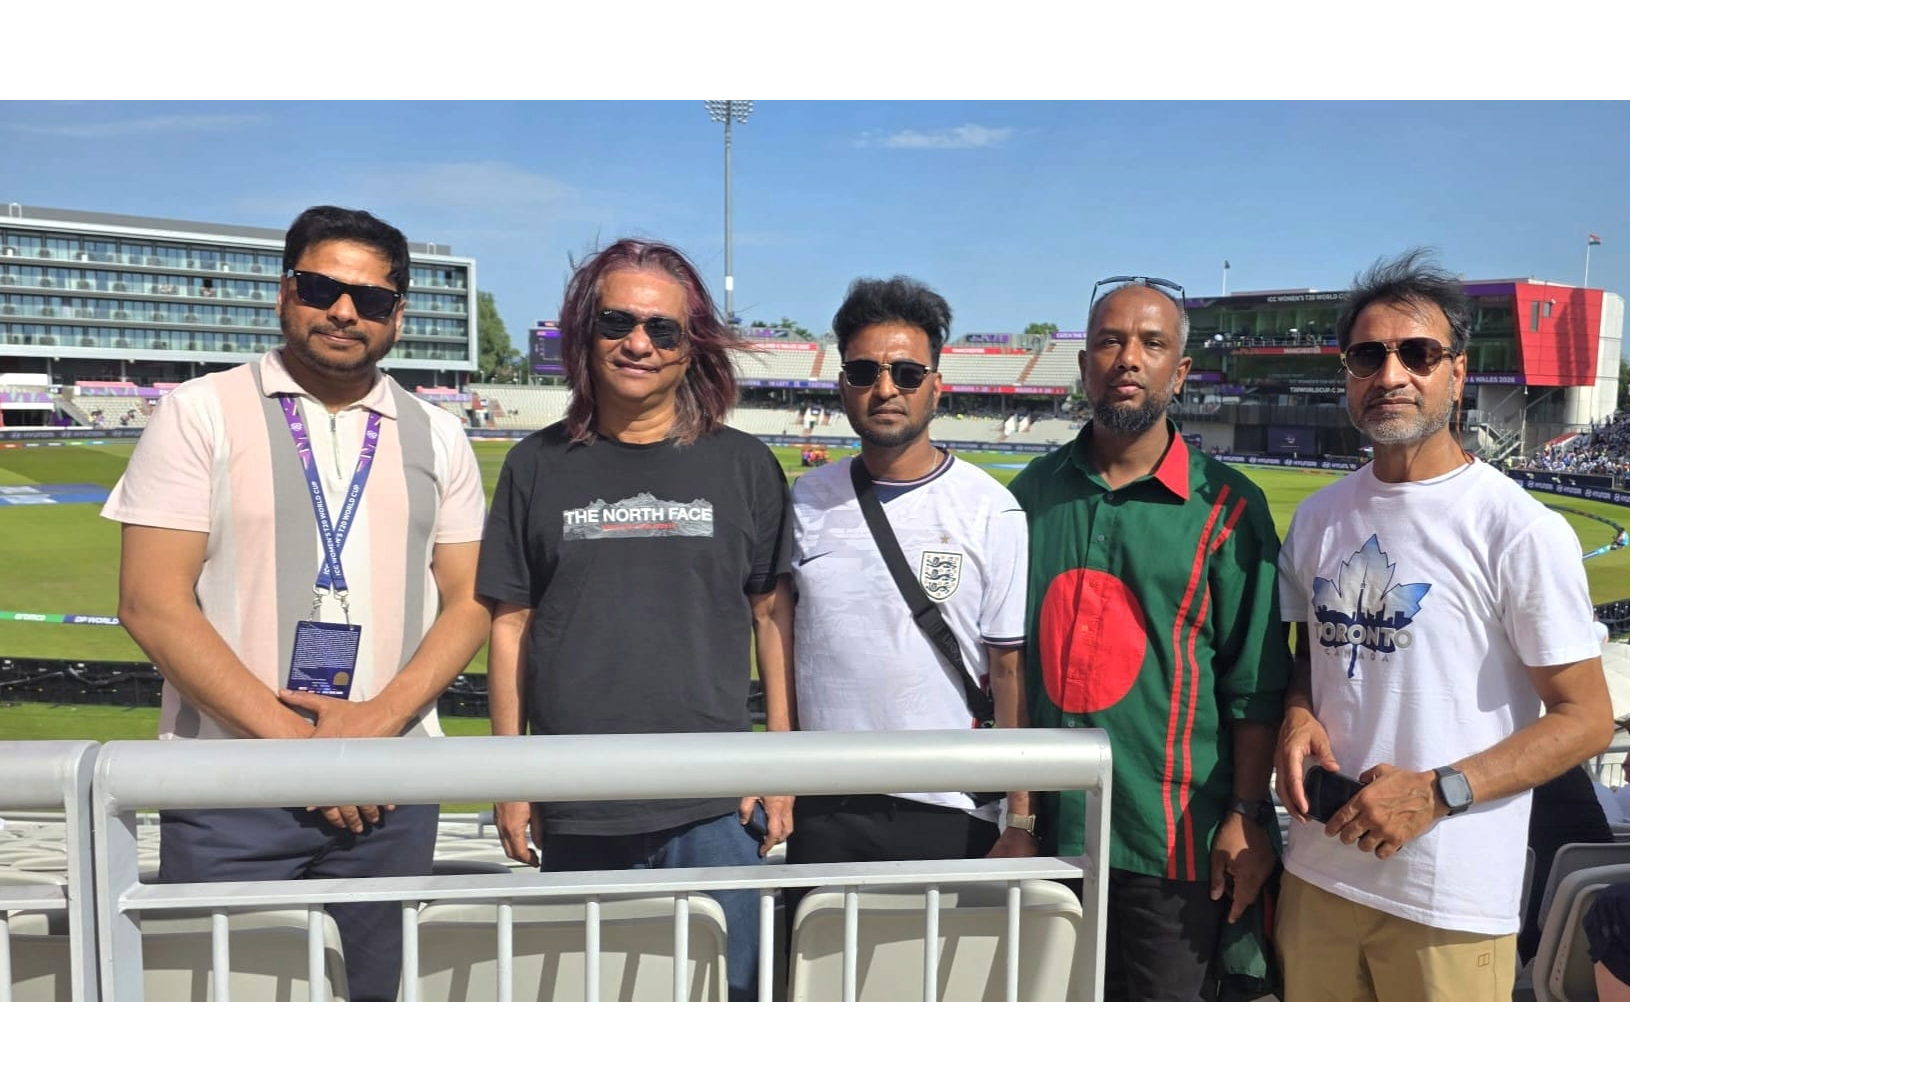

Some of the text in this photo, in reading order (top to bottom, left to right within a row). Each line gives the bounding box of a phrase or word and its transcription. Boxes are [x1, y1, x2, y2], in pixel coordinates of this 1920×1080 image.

[312, 481, 320, 494] CUP
[315, 495, 326, 520] WORLD
[342, 497, 356, 520] WORLD
[351, 484, 360, 497] CUP
[564, 507, 713, 525] THE NORTH FACE
[321, 519, 330, 532] T20
[87, 616, 120, 625] WORLD
[1314, 621, 1413, 649] TORONTO
[1324, 649, 1389, 662] CANADA
